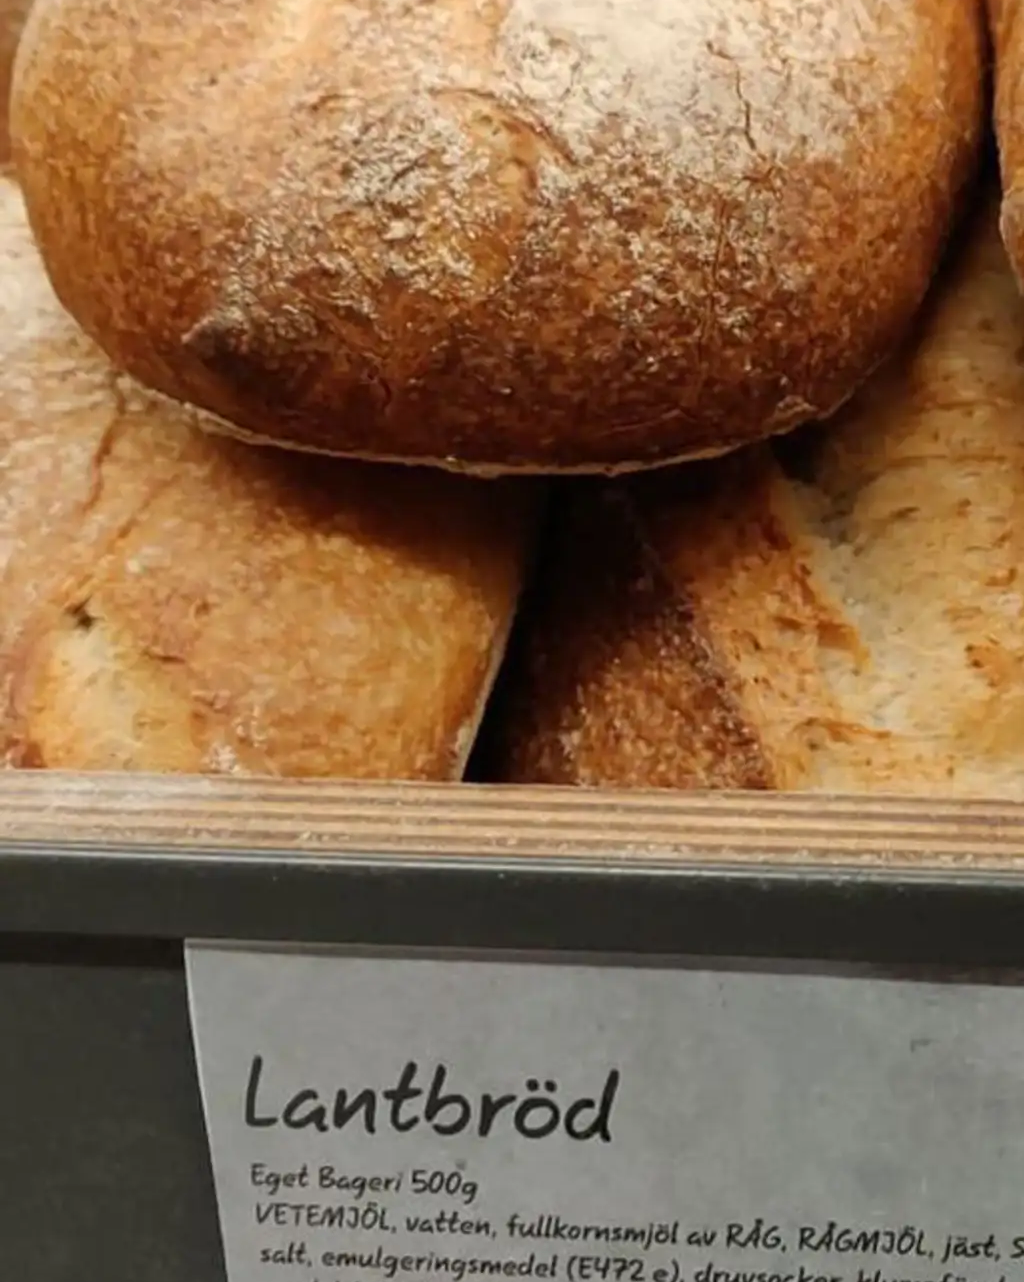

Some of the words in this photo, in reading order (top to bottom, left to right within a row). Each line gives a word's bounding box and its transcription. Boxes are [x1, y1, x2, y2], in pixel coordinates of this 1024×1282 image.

[245, 1055, 620, 1142] Lantbröd
[250, 1163, 309, 1196] Eget
[319, 1166, 402, 1198] Bageri
[411, 1170, 479, 1204] 500g
[256, 1202, 397, 1233] VETEMJÖL,
[406, 1213, 497, 1238] vatten,
[506, 1214, 678, 1251] fullkornsmjöl
[687, 1231, 716, 1248] av
[726, 1219, 786, 1252] RÅG,
[800, 1221, 934, 1259] RÅGMJÖL,
[942, 1233, 1000, 1263] jäst,
[260, 1245, 312, 1266] salt,
[321, 1246, 557, 1282] emulgeringsmedel
[566, 1255, 644, 1282] (E472
